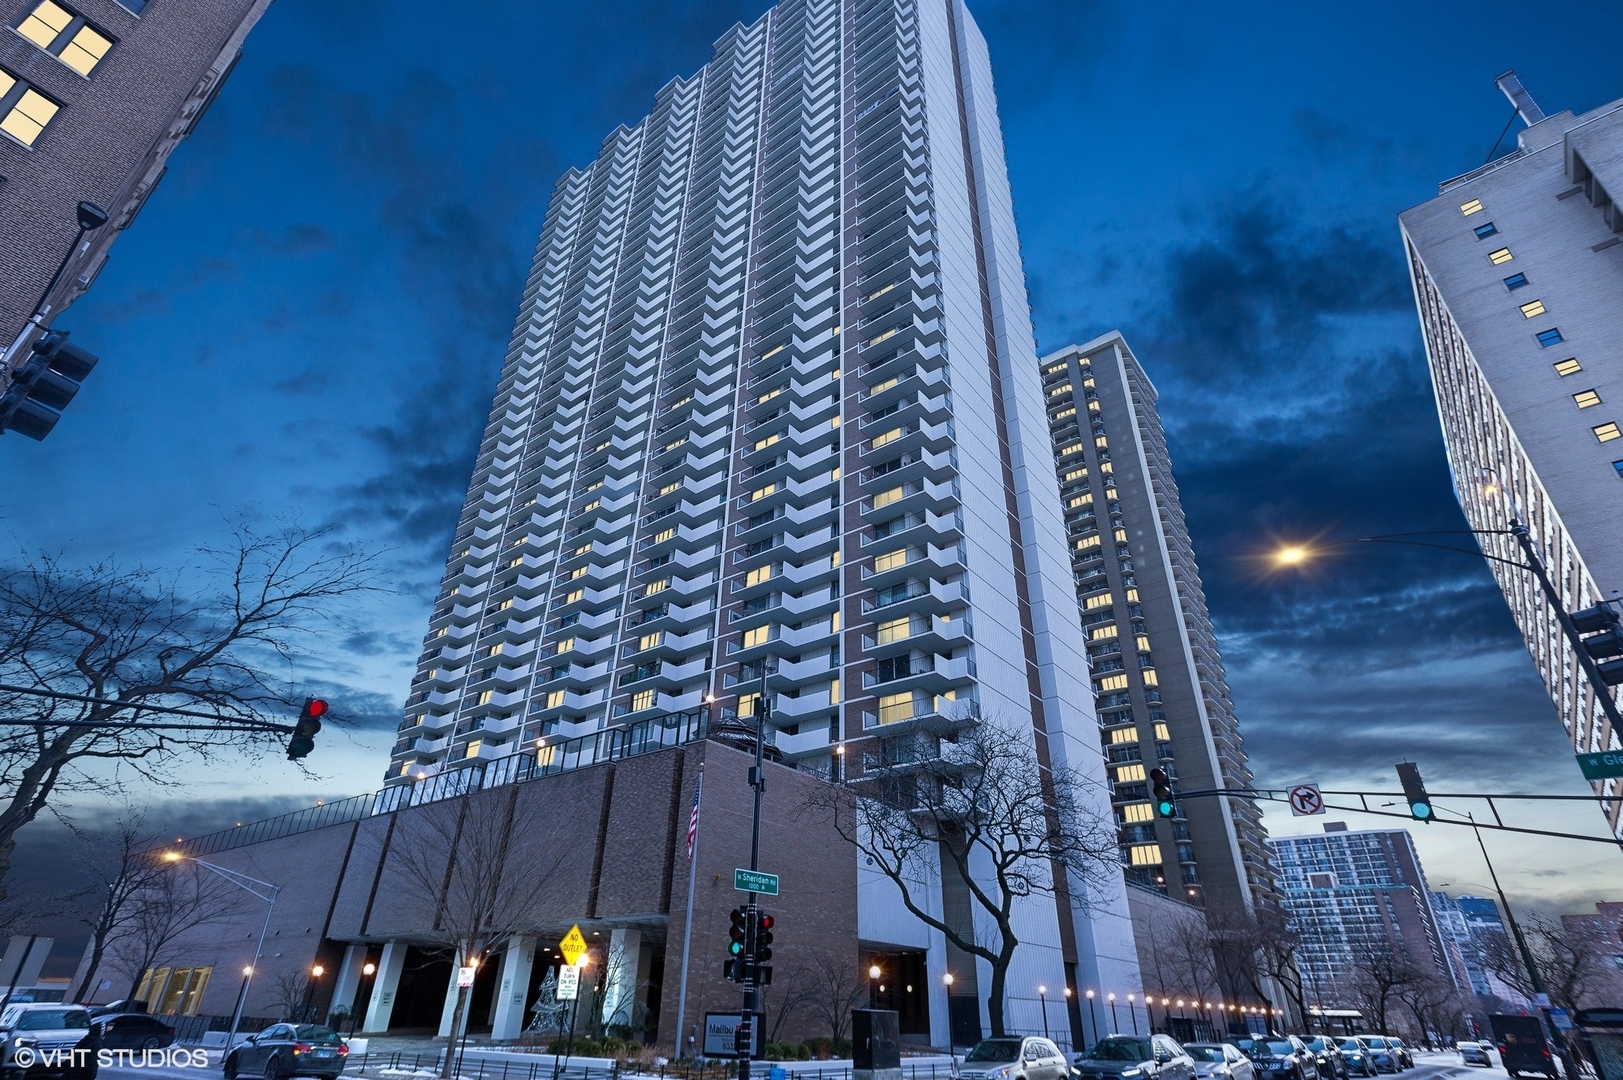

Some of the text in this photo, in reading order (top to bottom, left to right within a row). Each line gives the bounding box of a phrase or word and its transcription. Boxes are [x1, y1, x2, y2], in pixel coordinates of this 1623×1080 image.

[1588, 758, 1599, 766] W
[737, 873, 742, 881] N
[742, 872, 770, 885] Sheridan
[570, 933, 579, 942] NO
[562, 943, 583, 953] OUTLET
[565, 966, 575, 974] NO
[709, 1024, 734, 1035] Malibu
